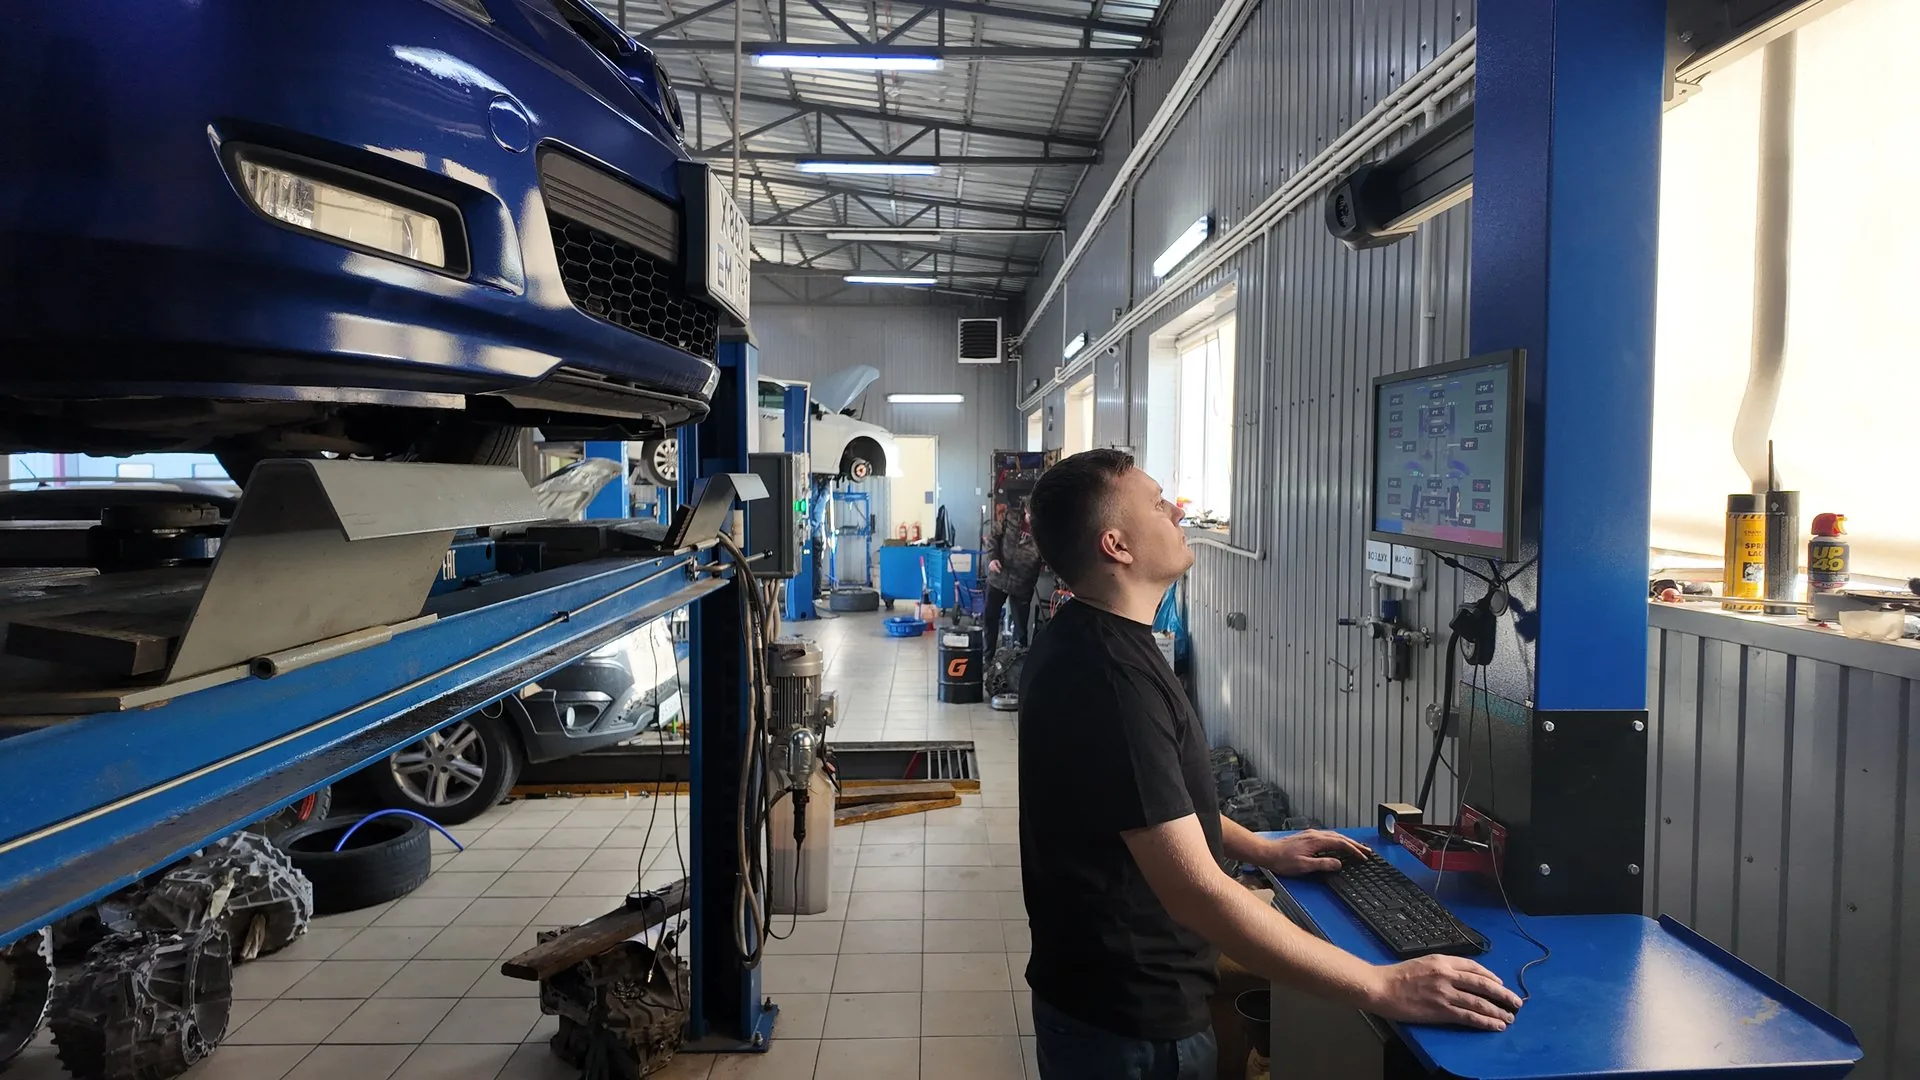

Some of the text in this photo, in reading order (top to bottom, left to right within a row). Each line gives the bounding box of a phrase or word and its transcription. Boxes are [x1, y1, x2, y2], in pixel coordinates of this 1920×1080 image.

[1367, 550, 1388, 563] ВОЗДУХ
[1813, 546, 1844, 559] UP
[1394, 555, 1413, 566] МАСЛО
[1813, 558, 1844, 571] 40
[947, 658, 969, 677] G
